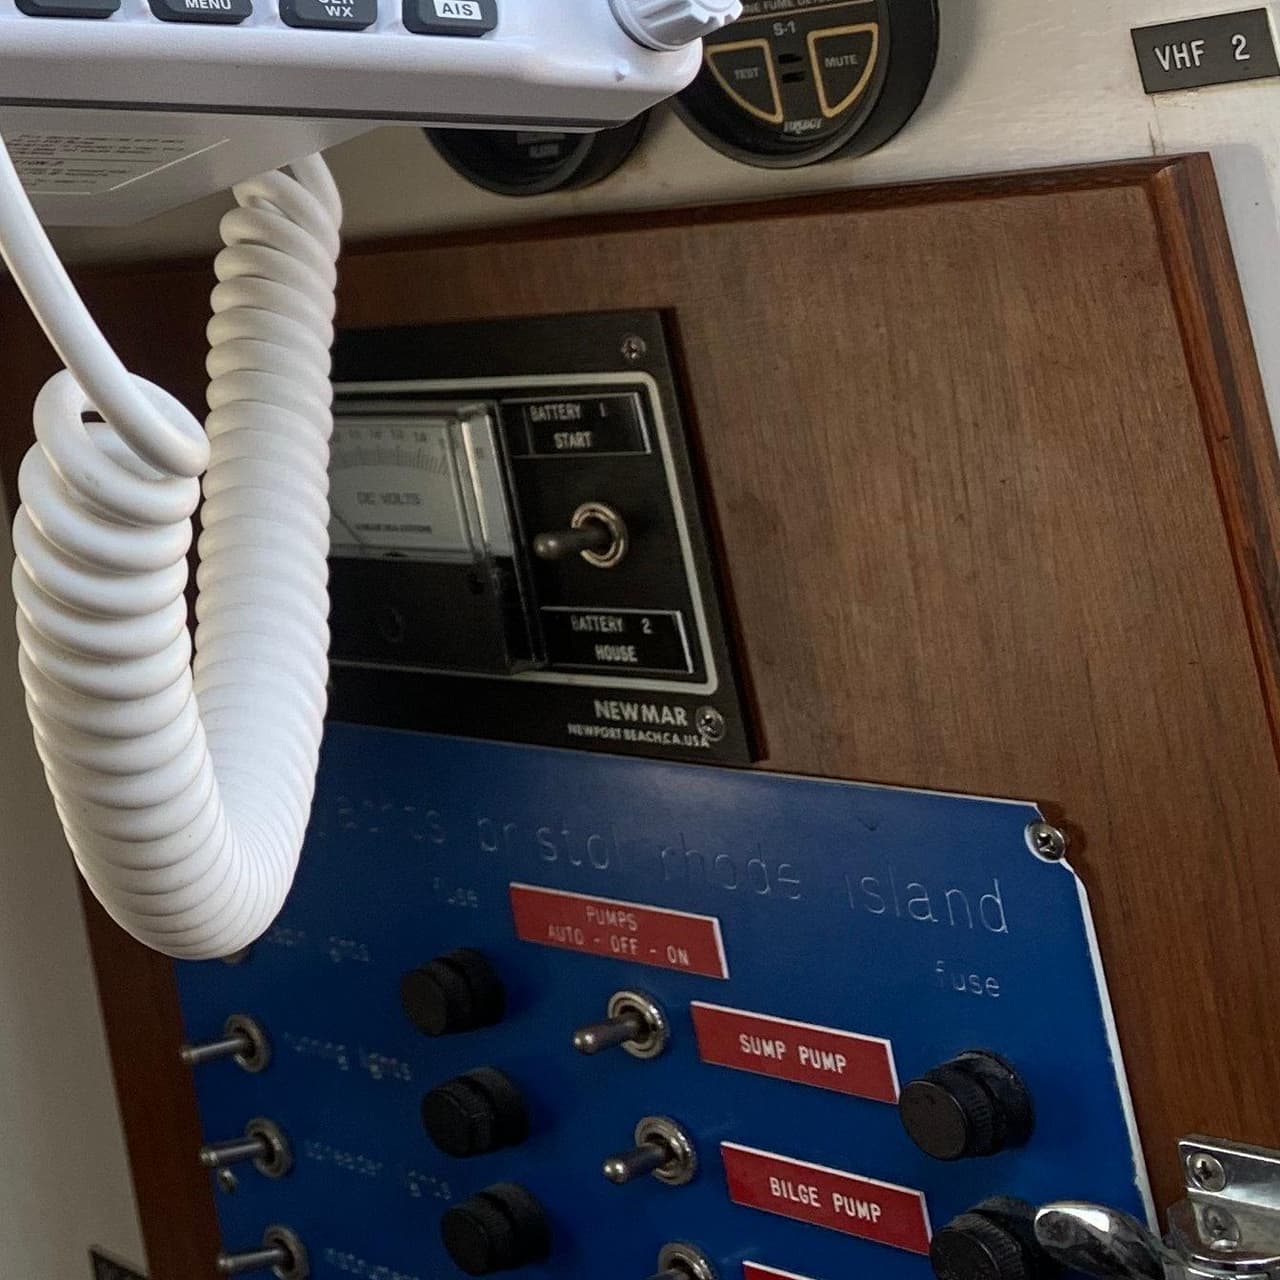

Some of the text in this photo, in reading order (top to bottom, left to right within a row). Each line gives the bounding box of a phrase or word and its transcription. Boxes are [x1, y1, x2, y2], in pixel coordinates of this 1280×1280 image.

[325, 3, 353, 18] WX
[441, 2, 474, 18] AIS
[763, 0, 794, 13] FUME
[772, 20, 796, 37] S-1
[824, 53, 858, 69] MUTE
[1153, 33, 1251, 71] VHF 2
[734, 66, 760, 81] TEST
[529, 402, 581, 422] BATTERY
[553, 430, 592, 450] START
[570, 614, 653, 635] BATTERY 2
[594, 644, 638, 663] HOUSE
[593, 698, 688, 727] NEWMAR
[586, 905, 639, 932] PUMPS
[547, 923, 585, 946] AUTO
[610, 936, 640, 956] OFF
[666, 944, 690, 966] ON
[739, 1032, 848, 1075] SUMP PUMP
[769, 1176, 882, 1224] BILGE PUMP
